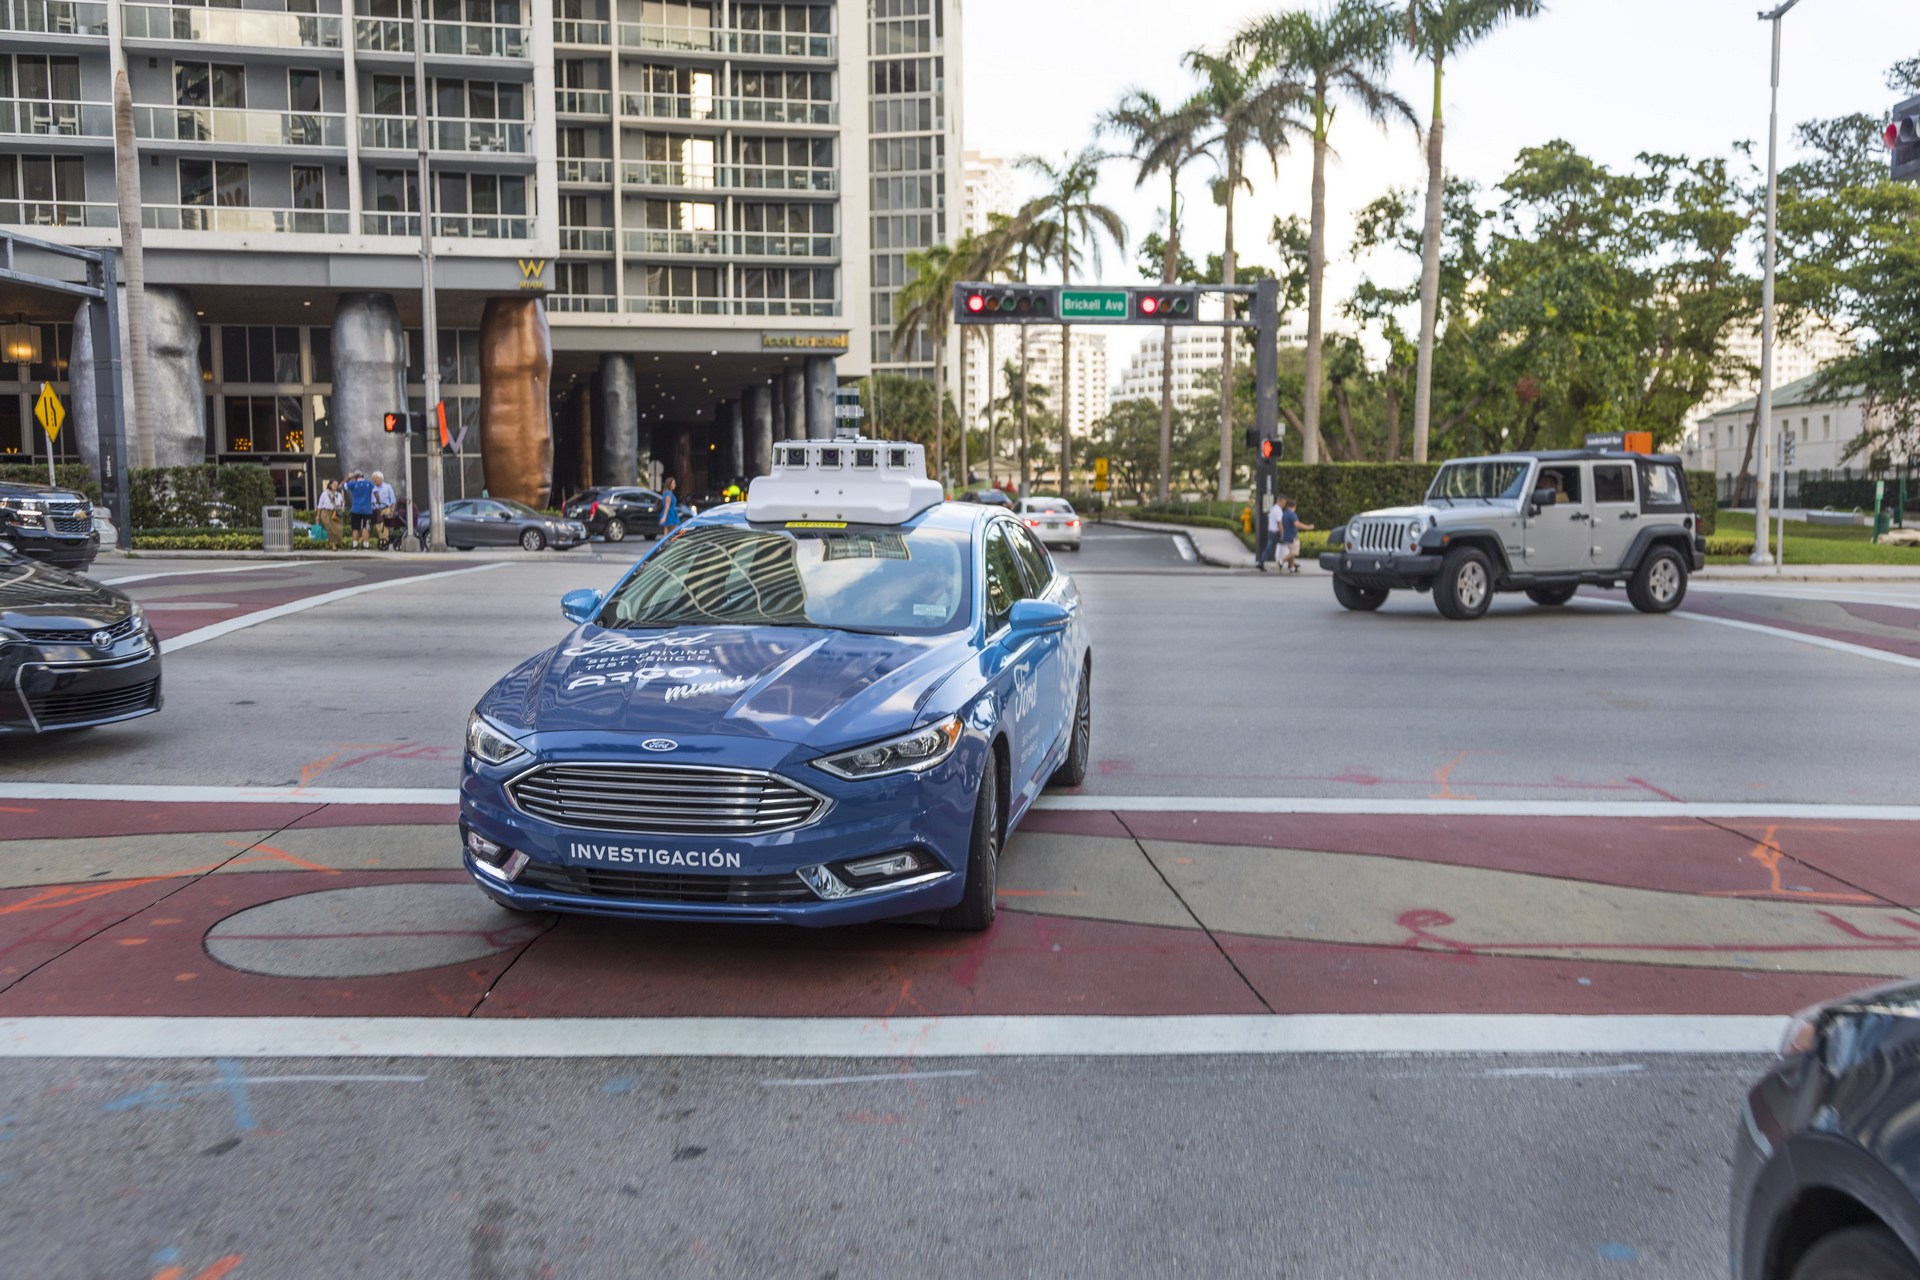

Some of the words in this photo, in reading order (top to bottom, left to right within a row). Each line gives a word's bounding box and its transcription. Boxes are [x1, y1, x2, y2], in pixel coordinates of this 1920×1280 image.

[518, 259, 545, 278] W
[1064, 298, 1101, 311] Brickell
[1105, 299, 1124, 311] Ave
[562, 632, 713, 656] Ford
[585, 660, 629, 671] TEST
[635, 655, 707, 664] VEHICLE
[588, 649, 711, 664] SELF-DRIVING
[567, 666, 702, 691] ARGO
[664, 675, 746, 703] Miami
[1014, 660, 1038, 722] Ford
[570, 843, 741, 868] INVESTIGACIÓN
